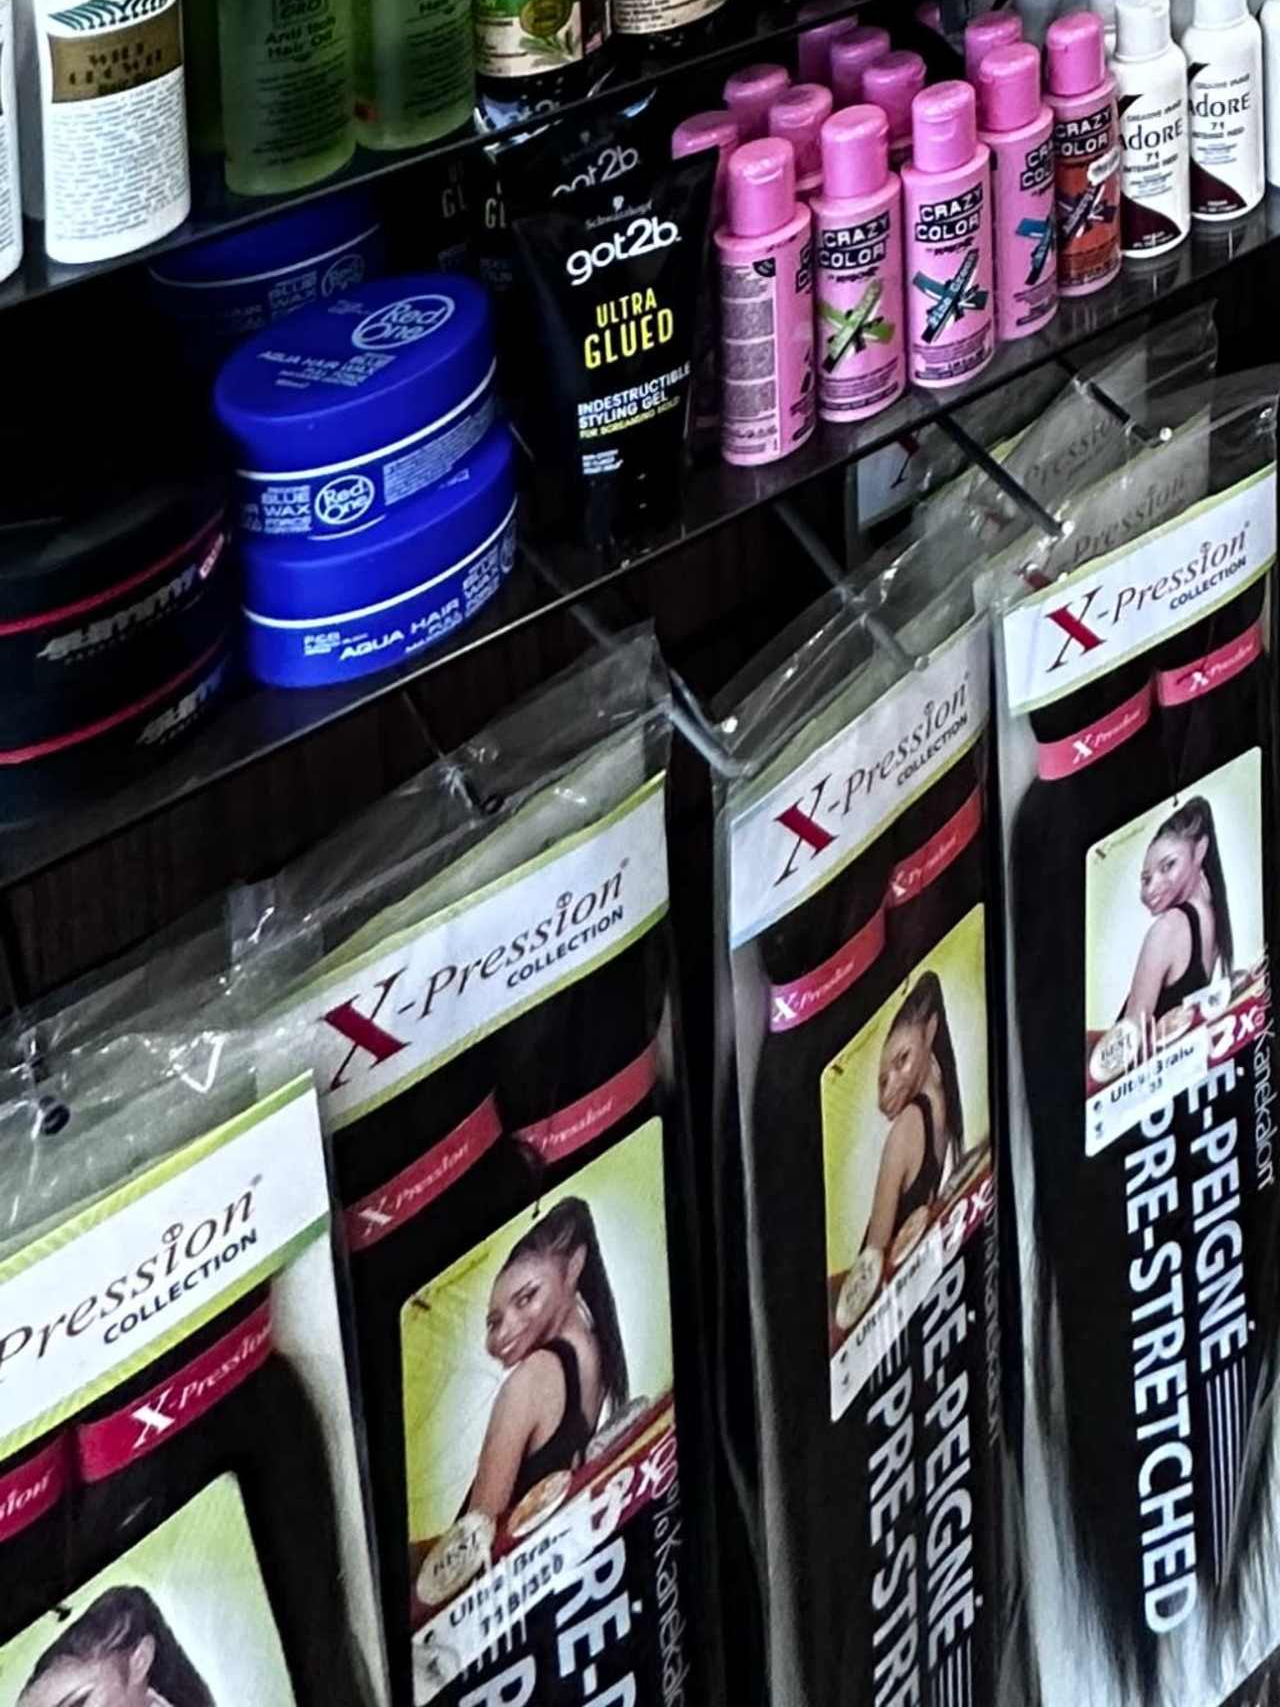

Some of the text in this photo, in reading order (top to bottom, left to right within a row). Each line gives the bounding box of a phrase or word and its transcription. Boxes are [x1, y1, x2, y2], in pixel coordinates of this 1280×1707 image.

[1056, 111, 1112, 138] CRAZY
[1208, 118, 1226, 131] 71
[1145, 149, 1161, 162] 71
[915, 214, 980, 242] COLOR
[919, 185, 982, 222] CRAZY
[566, 215, 680, 287] got2b
[823, 212, 890, 250] CRAZY
[820, 243, 887, 269] COLOR
[595, 287, 658, 329] ULTRA
[583, 307, 674, 370] GLUED
[577, 360, 692, 418] INDESTRUCTIBLE
[578, 390, 669, 430] STYLING GEL
[262, 503, 310, 517] WAX
[322, 481, 365, 505] Red
[326, 496, 369, 521] One
[1045, 525, 1249, 673] X-Pression
[1169, 554, 1248, 611] COLLECTION
[339, 597, 460, 661] AQUA HAIR
[896, 712, 969, 788] COLLECTION
[774, 677, 969, 887] X-Pression
[506, 905, 625, 990] COLLECTION
[323, 862, 626, 1092] X-Pression
[102, 1227, 258, 1347] COLLECTION
[1123, 1095, 1202, 1637] PRE-STRETCHED
